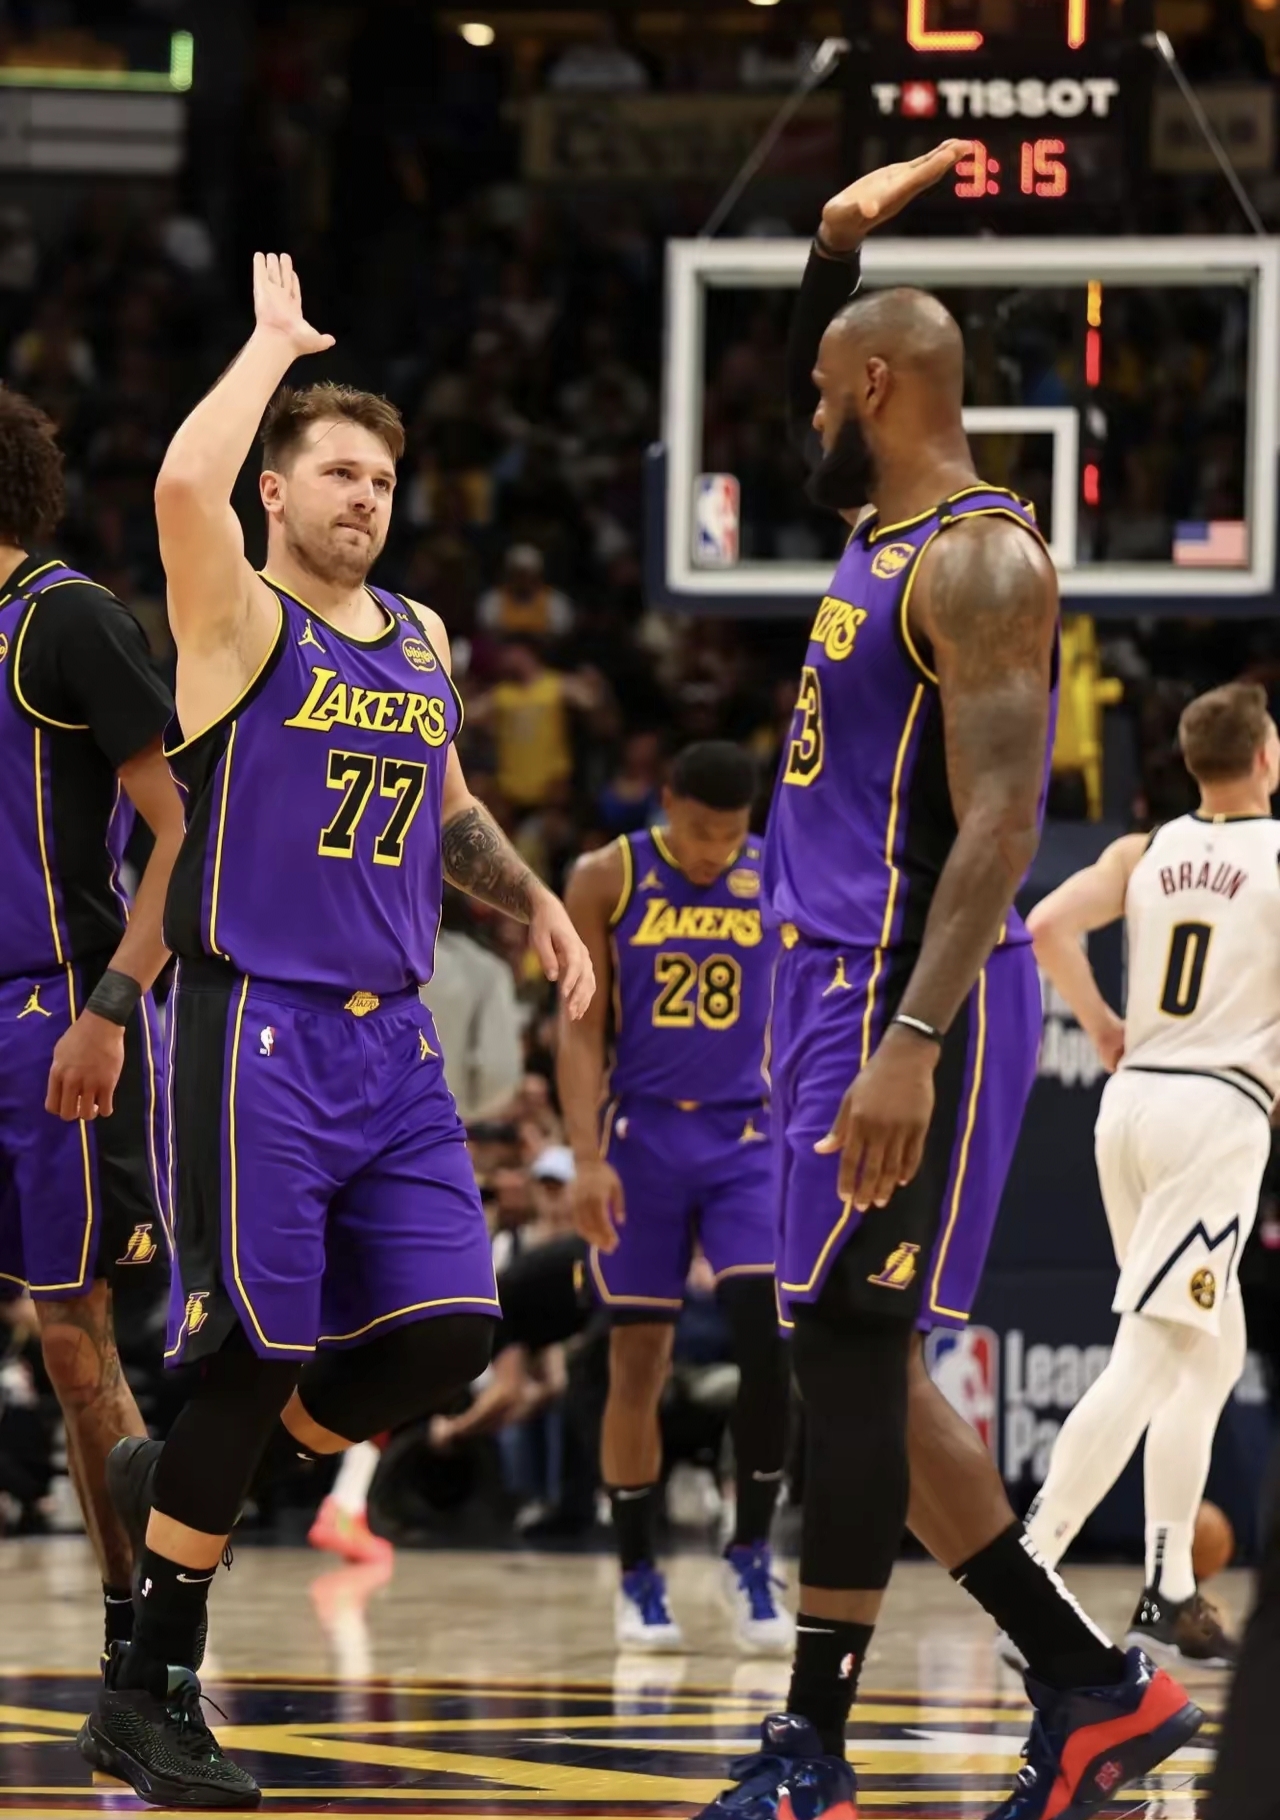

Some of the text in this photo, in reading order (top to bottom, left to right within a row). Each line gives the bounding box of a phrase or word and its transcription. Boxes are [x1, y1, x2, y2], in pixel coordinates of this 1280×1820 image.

[937, 77, 1119, 119] TISSOT
[282, 665, 449, 748] LAKERS
[317, 748, 428, 867] 77
[1159, 859, 1249, 900] BRAUN
[628, 897, 763, 948] LAKERS
[652, 951, 742, 1031] 28
[1159, 920, 1214, 1019] 0
